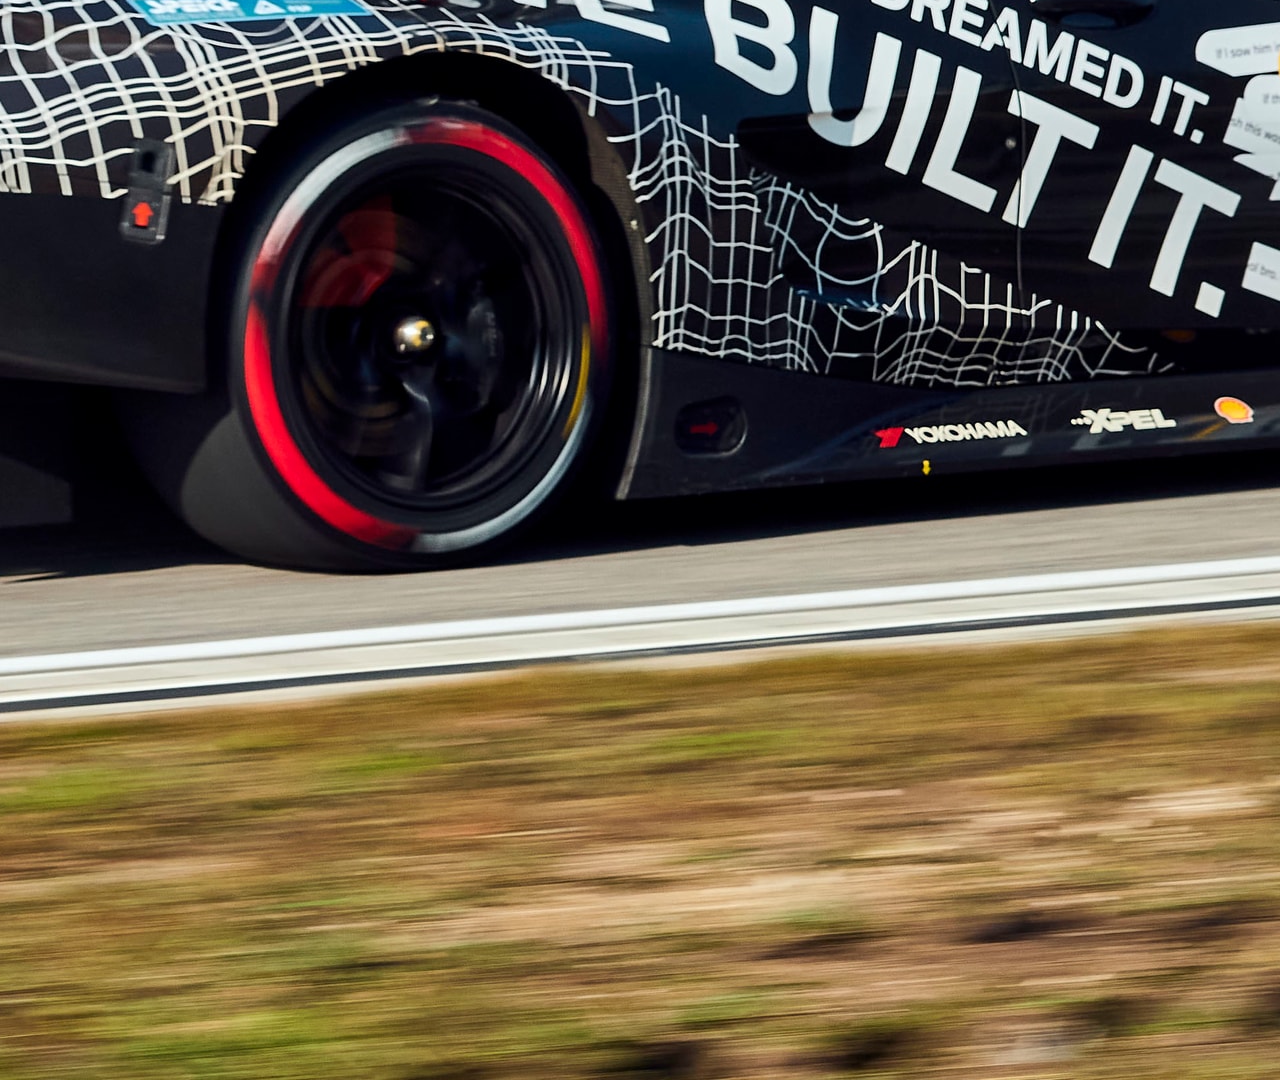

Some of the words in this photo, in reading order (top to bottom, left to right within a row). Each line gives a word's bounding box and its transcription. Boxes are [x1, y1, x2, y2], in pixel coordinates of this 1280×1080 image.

[1150, 75, 1211, 145] IT.
[1087, 143, 1242, 319] IT.
[903, 420, 1028, 444] YOKOHAMA
[1078, 408, 1177, 434] XPEL
